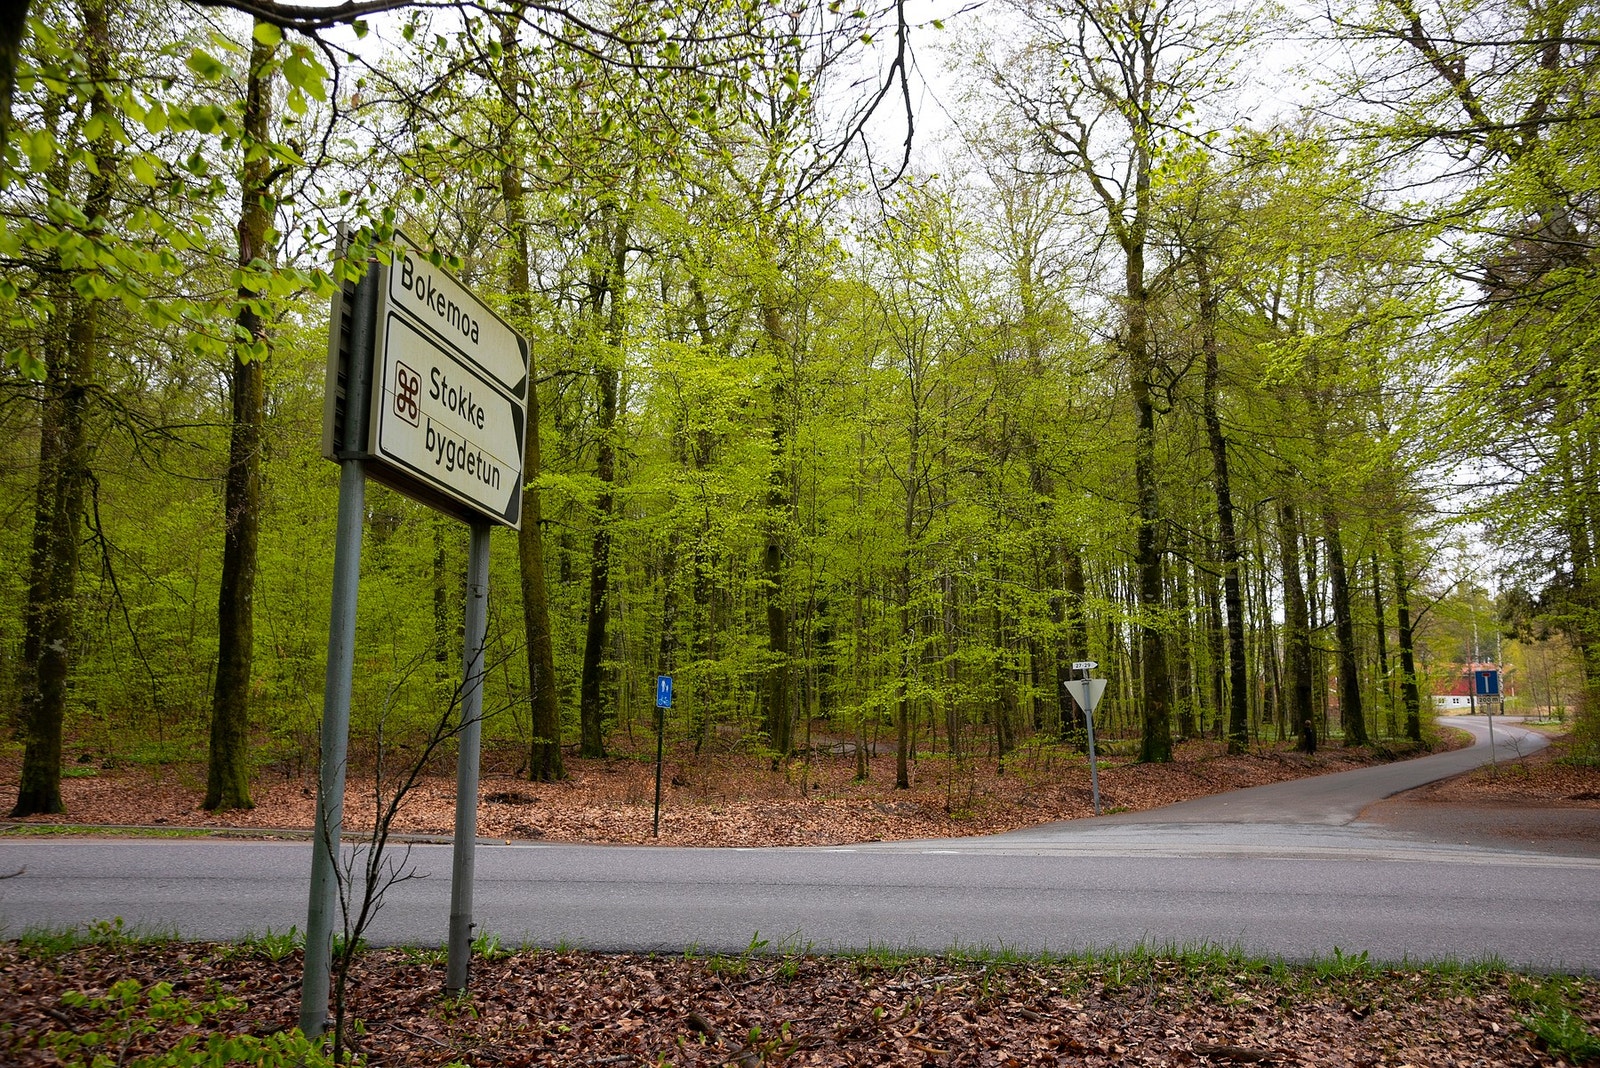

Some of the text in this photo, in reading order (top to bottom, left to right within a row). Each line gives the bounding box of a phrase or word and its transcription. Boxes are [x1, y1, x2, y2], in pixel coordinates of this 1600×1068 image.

[401, 255, 479, 345] Bokemoa
[429, 366, 485, 430] Stokke
[425, 417, 500, 491] bygdetun
